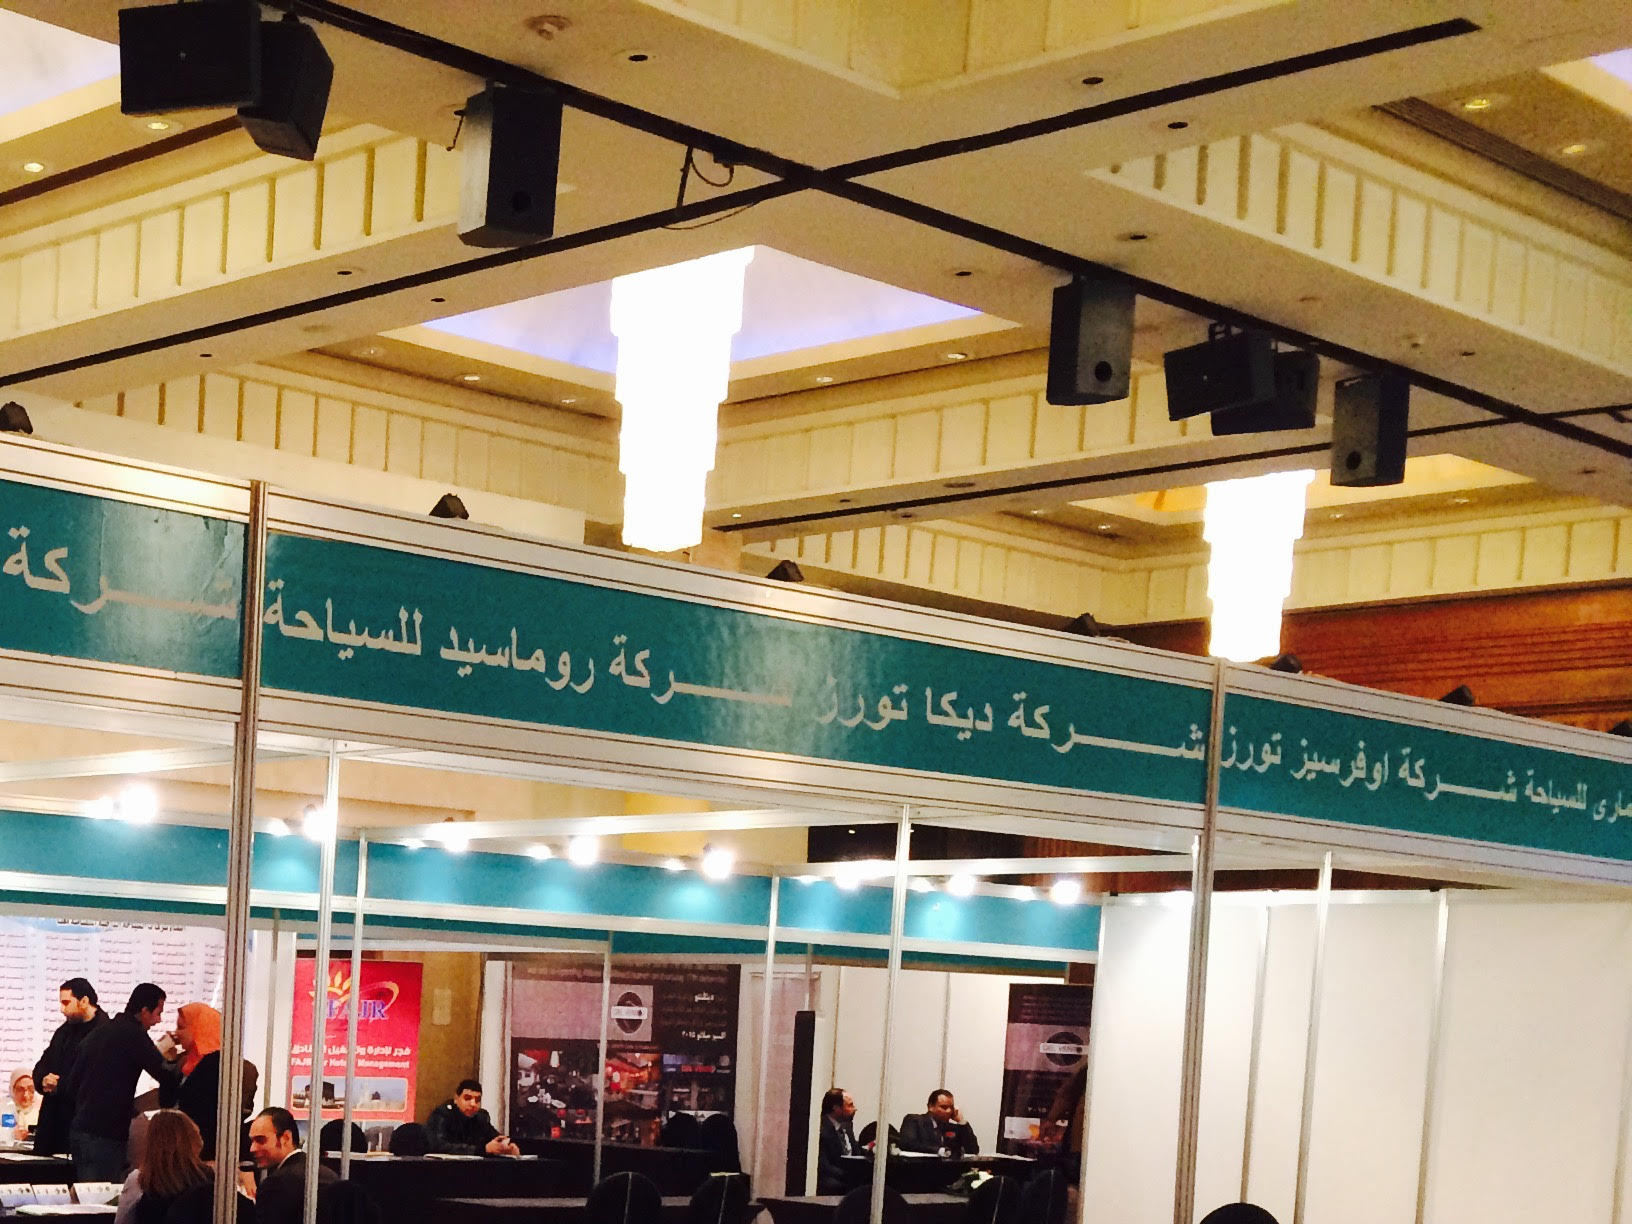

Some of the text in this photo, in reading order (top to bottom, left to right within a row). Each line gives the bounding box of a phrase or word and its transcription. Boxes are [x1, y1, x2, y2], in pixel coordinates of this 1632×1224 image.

[2, 526, 238, 621] شركة
[262, 578, 424, 661] للسياحة
[440, 626, 596, 695] روماسيد
[814, 671, 1206, 761] شركة ديكا تورز
[1220, 726, 1518, 802] شركة اوفرسيز تورز
[1524, 768, 1588, 816] للسياحة
